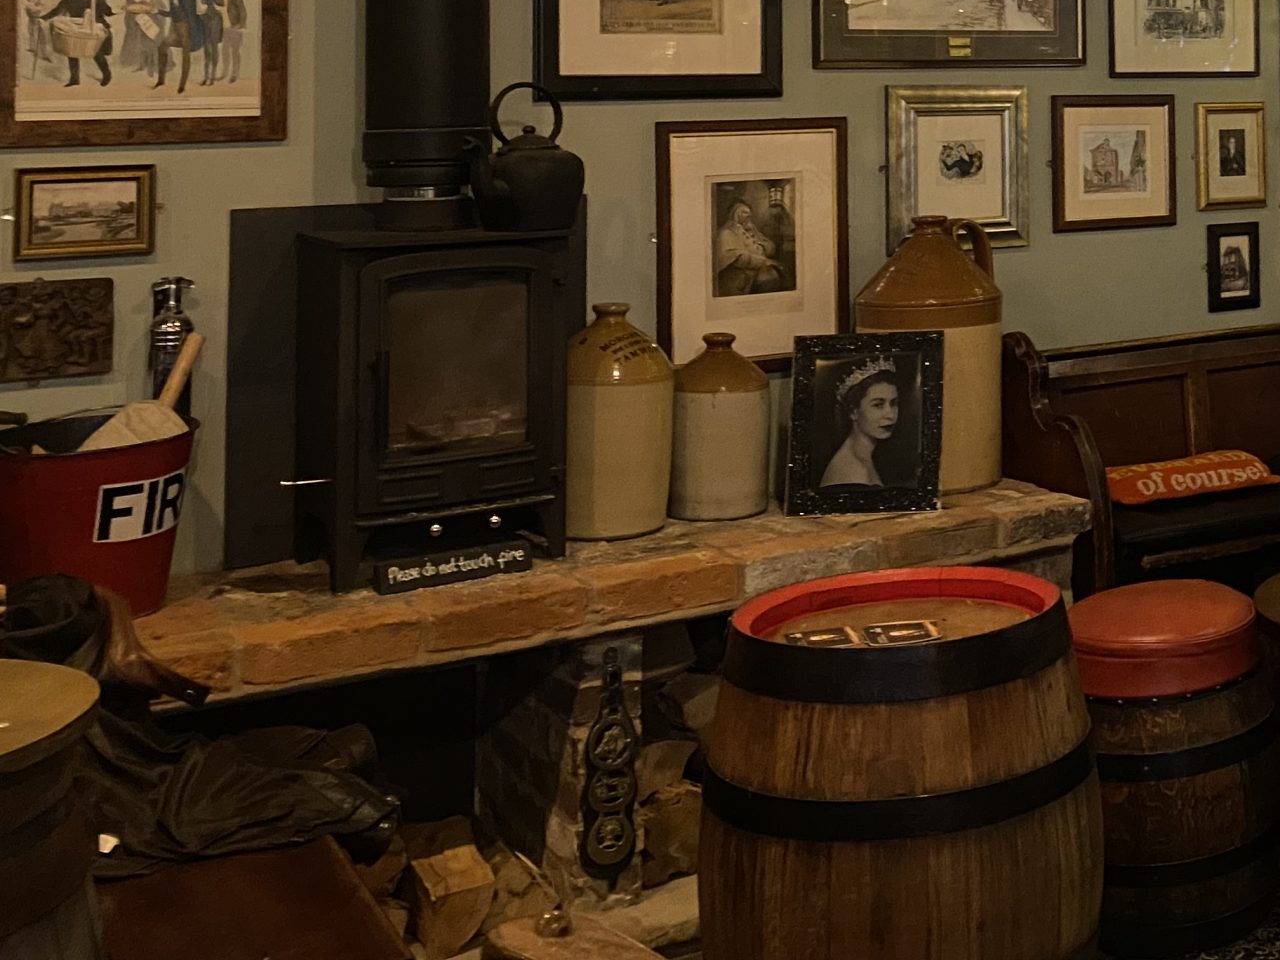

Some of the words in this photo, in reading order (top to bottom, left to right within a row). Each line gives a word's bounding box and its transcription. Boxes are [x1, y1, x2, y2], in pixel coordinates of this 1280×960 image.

[388, 566, 421, 584] Please
[421, 562, 438, 576] do
[437, 557, 457, 575] not
[458, 553, 495, 572] touch
[497, 548, 525, 569] fire
